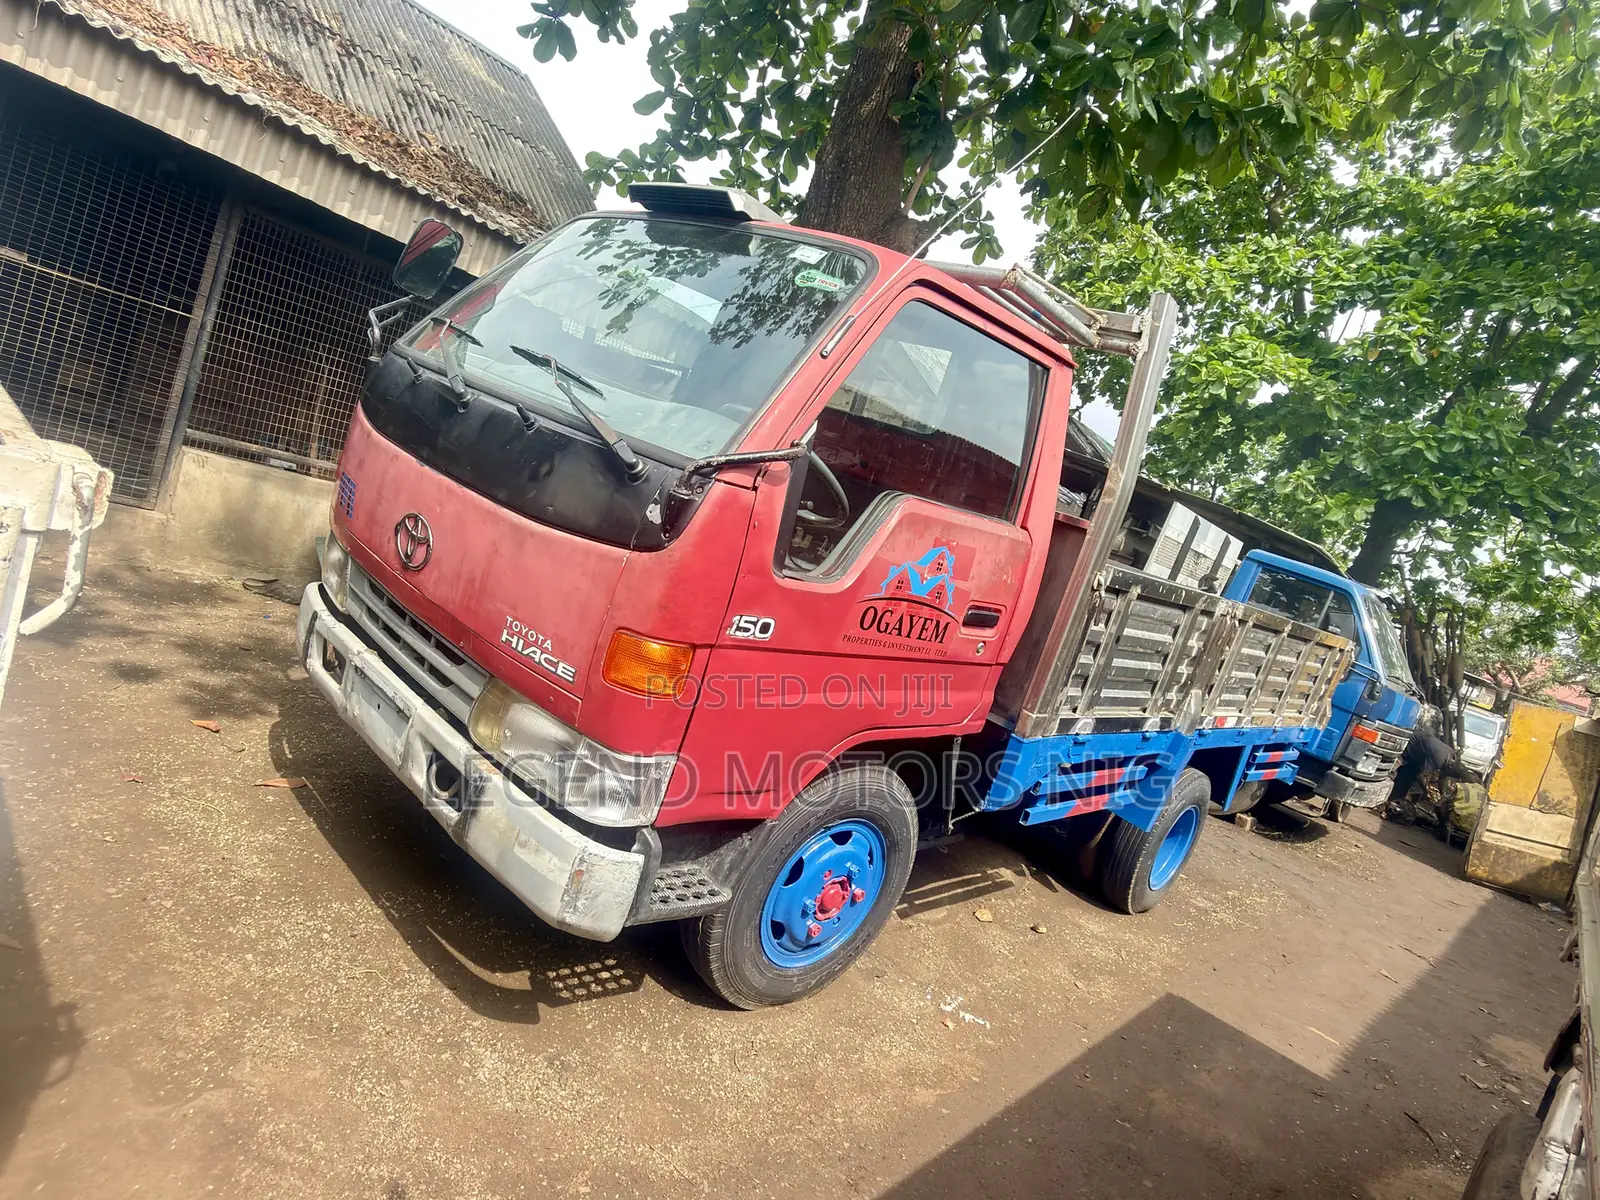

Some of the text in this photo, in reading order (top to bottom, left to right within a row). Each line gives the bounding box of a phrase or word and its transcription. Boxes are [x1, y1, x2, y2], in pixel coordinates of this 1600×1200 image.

[818, 279, 838, 288] TRUCK
[506, 615, 552, 652] TOYOTA
[729, 614, 776, 638] 150
[859, 605, 951, 644] OGAYEM
[501, 628, 576, 682] HIACE
[842, 634, 882, 647] PROPERTIES
[882, 640, 887, 649] &
[887, 641, 925, 655] INVESTMENT
